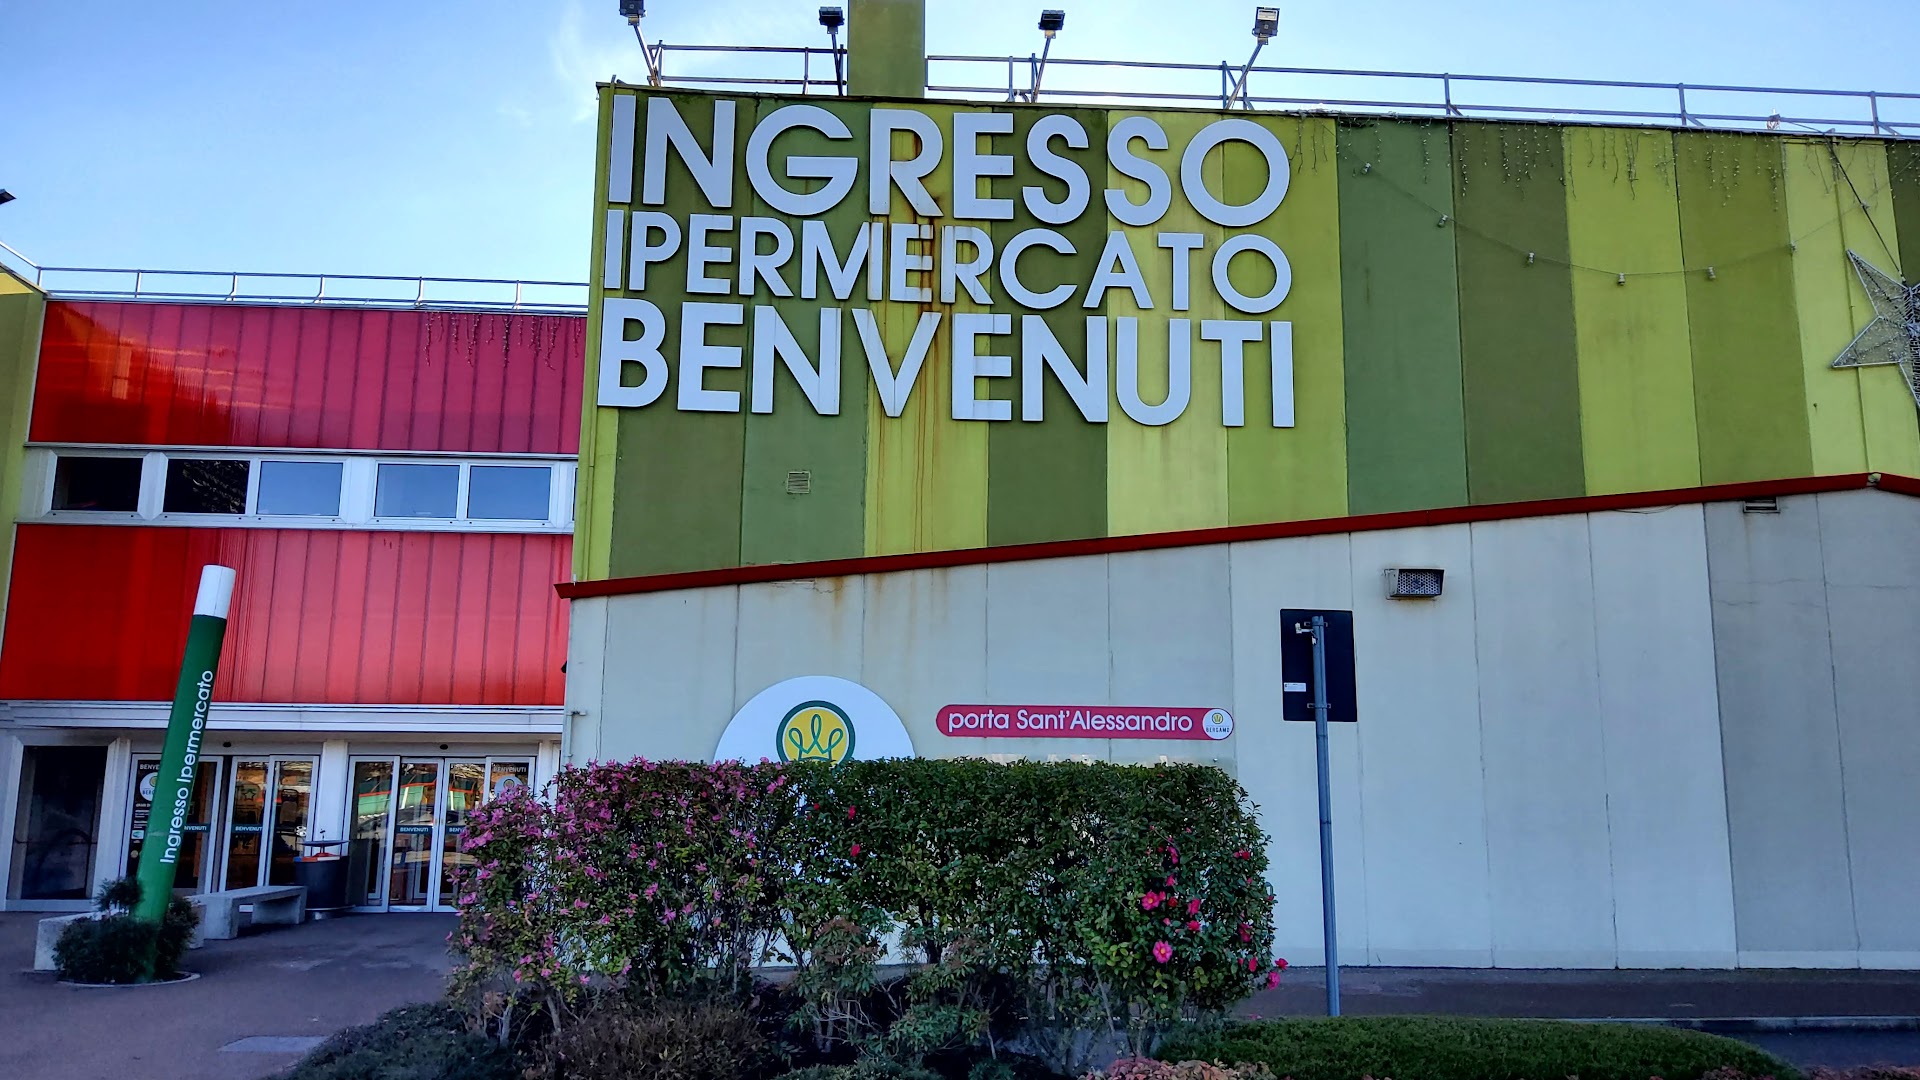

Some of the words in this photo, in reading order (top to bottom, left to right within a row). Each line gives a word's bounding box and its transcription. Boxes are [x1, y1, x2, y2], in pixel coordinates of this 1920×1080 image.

[608, 94, 1290, 227] INGRESSO
[604, 209, 1291, 313] IPERMERCATO
[597, 297, 1295, 428] BENVENUTI
[160, 787, 189, 864] Ingresso
[176, 670, 213, 783] Ipermercato
[948, 710, 1010, 733] porta
[1016, 709, 1193, 732] Sant'Alessandro
